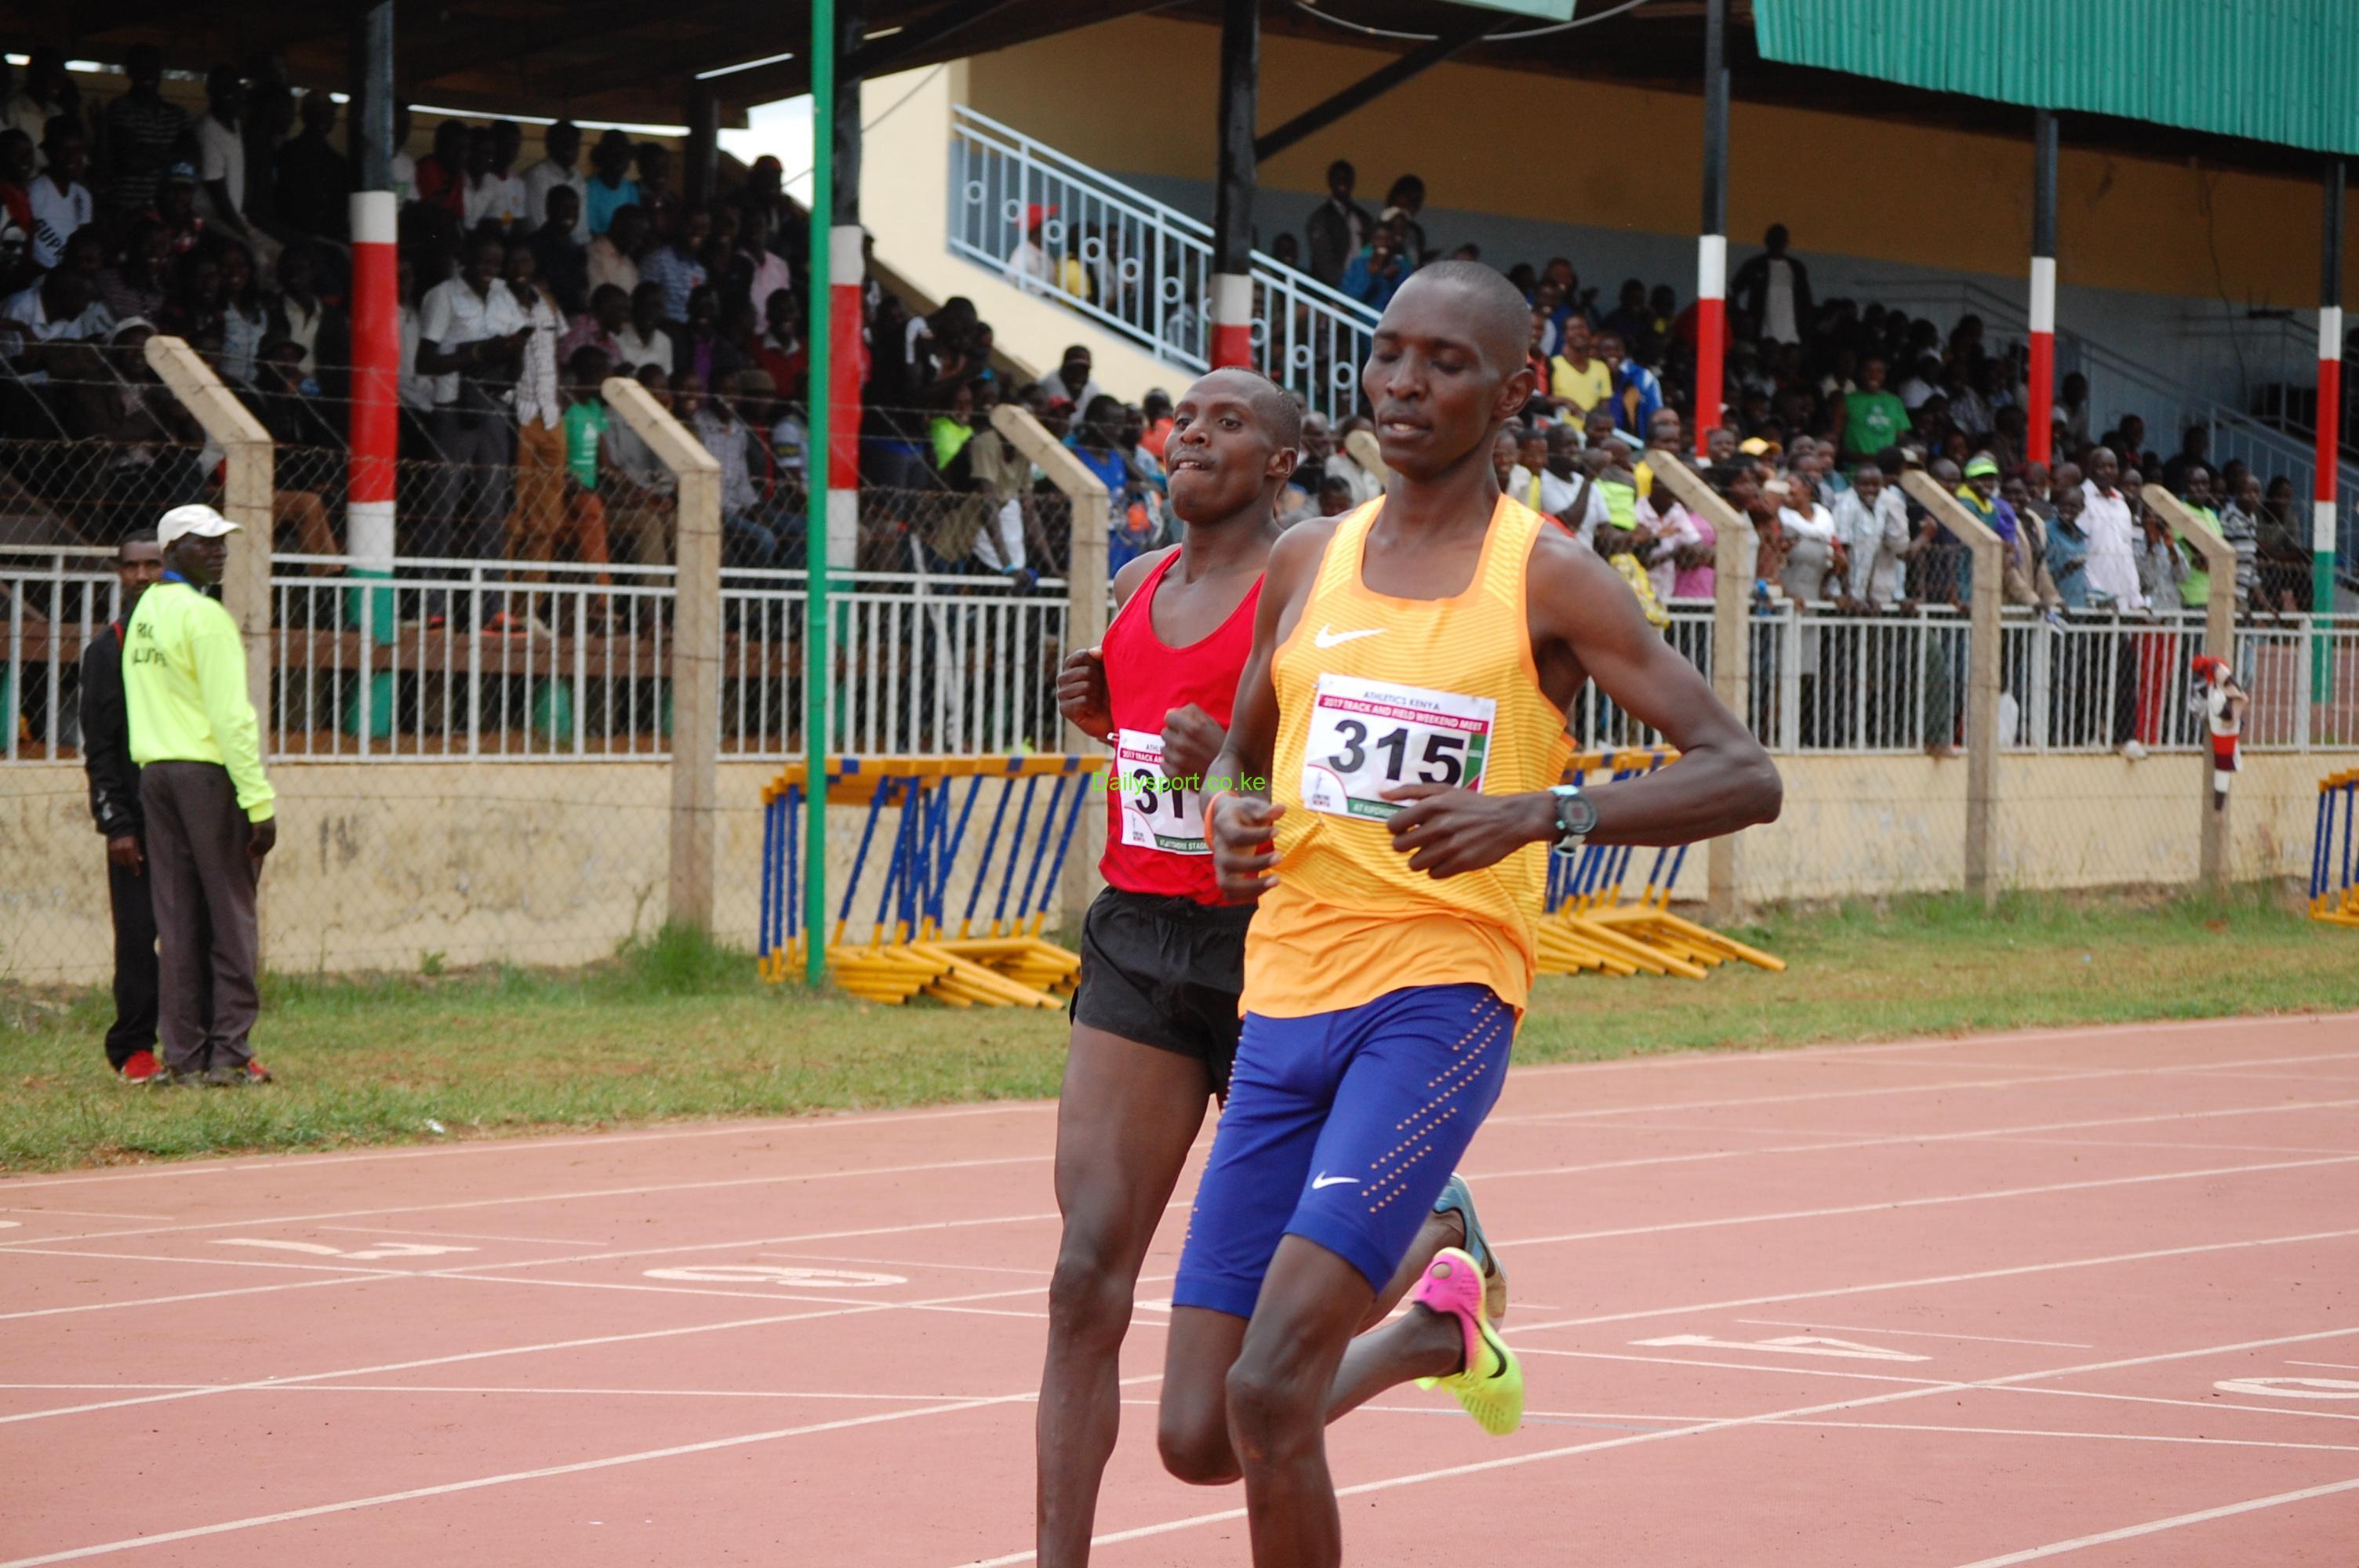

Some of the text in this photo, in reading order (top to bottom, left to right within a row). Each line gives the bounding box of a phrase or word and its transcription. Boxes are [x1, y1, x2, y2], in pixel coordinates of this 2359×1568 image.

[1324, 697, 1483, 732] 2017 TRACK AND FIELD WEEKEND MEET
[1363, 691, 1440, 711] ATHLETICS KENYA
[1123, 750, 1135, 759] 2017
[1136, 752, 1153, 762] TRACK
[1329, 719, 1465, 789] 315
